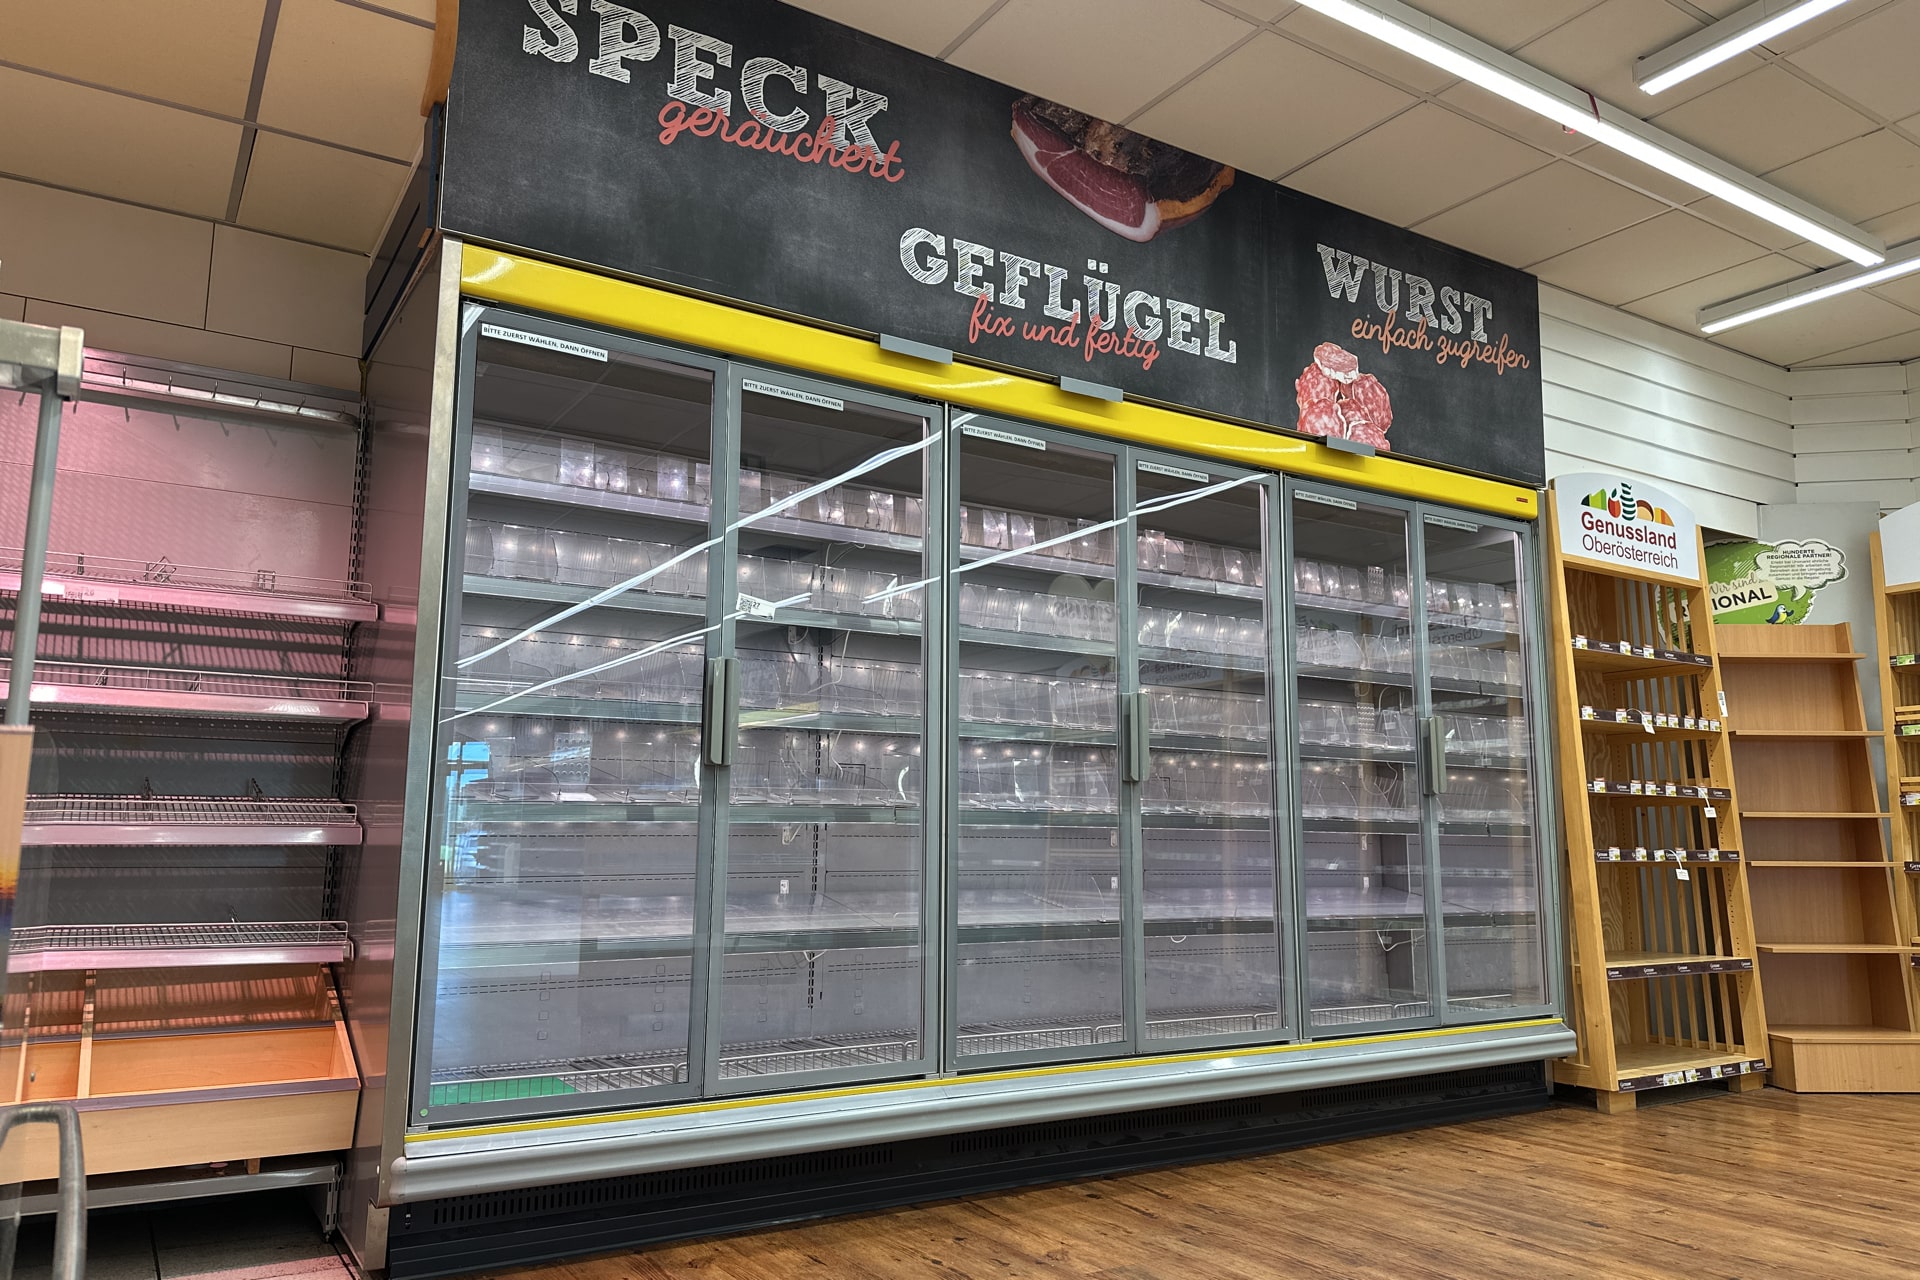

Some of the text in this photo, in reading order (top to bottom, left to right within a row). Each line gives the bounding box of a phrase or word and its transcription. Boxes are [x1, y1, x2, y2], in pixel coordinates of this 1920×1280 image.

[523, 0, 889, 164] SPECK
[658, 100, 905, 182] geräuchert
[900, 227, 1237, 363] GEFLÜGEL
[1317, 243, 1493, 343] WURST
[484, 327, 501, 335] BITTE
[502, 330, 527, 341] ZUERST
[560, 343, 579, 353] DANN
[580, 347, 605, 358] ÖFFNEN
[969, 293, 1161, 370] fix und fertig
[1351, 309, 1530, 376] einfach zugreifen
[759, 385, 779, 394] ZUERST
[805, 395, 821, 403] DANN
[1581, 511, 1677, 550] Genussland
[1582, 534, 1678, 569] Oberösterreich
[1732, 572, 1757, 590] sind
